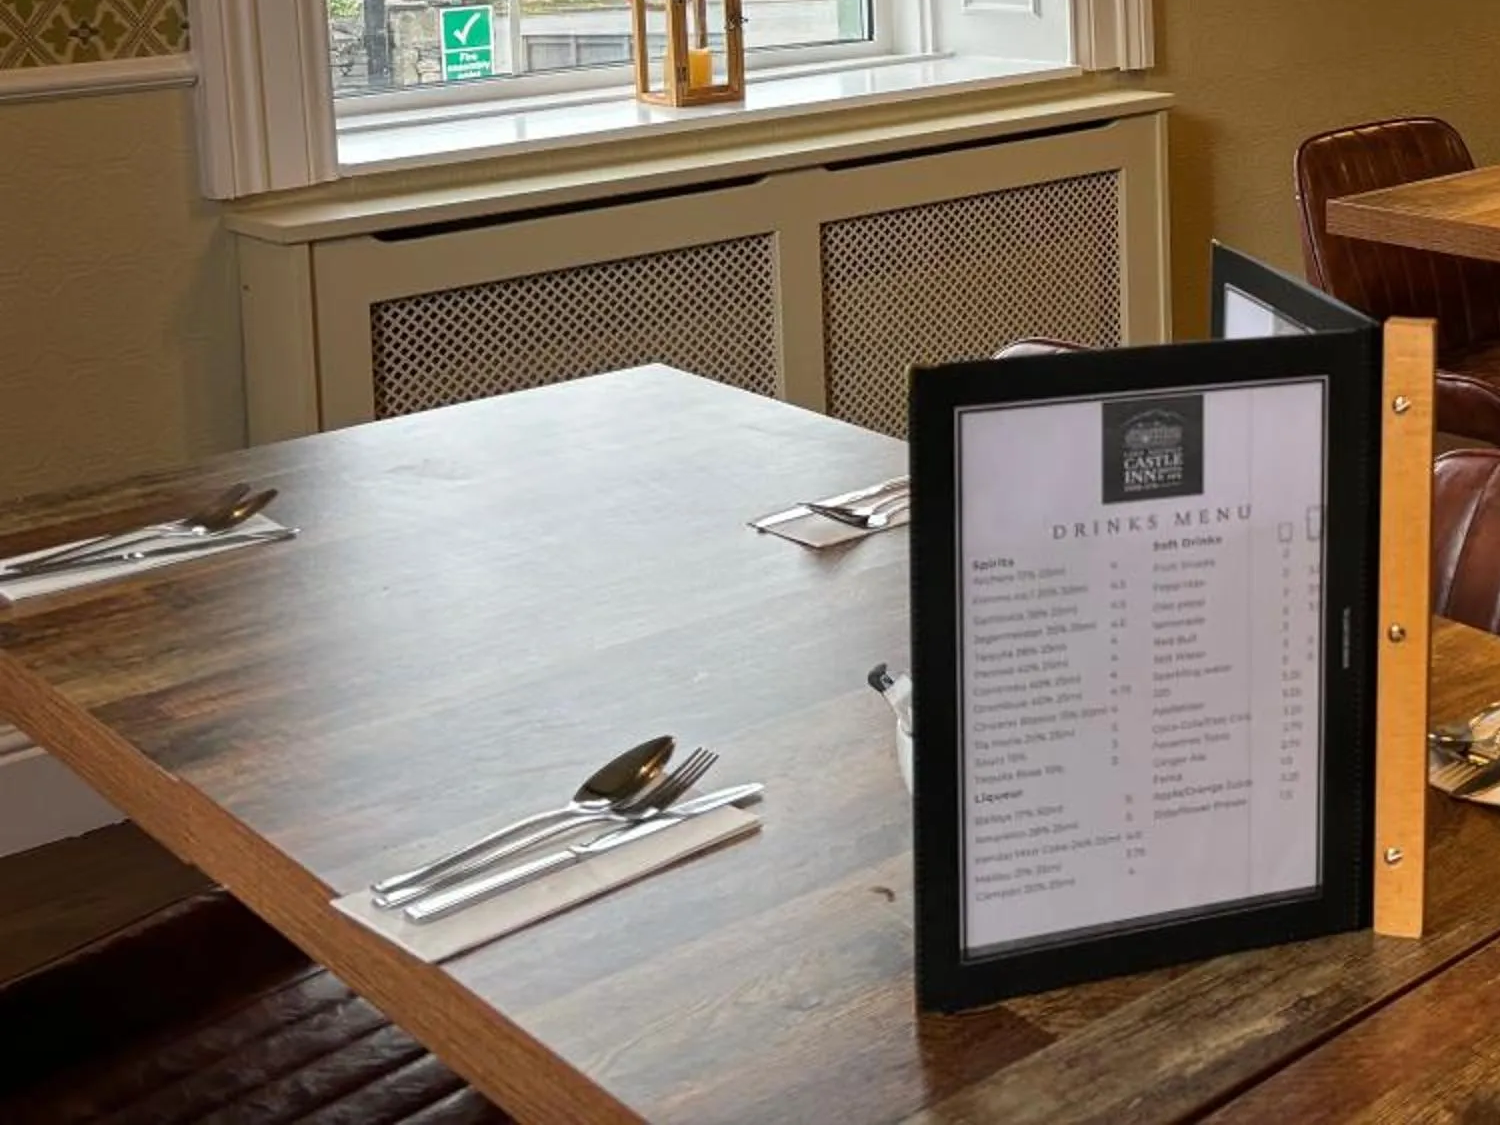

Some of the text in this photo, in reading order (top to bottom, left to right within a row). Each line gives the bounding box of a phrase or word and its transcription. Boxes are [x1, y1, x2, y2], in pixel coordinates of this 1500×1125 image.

[1123, 453, 1184, 468] CASTLE
[1124, 468, 1156, 484] INN
[1052, 504, 1252, 540] DRINKS MENU
[973, 557, 1015, 572] Spirits
[974, 788, 1024, 805] Liqueur
